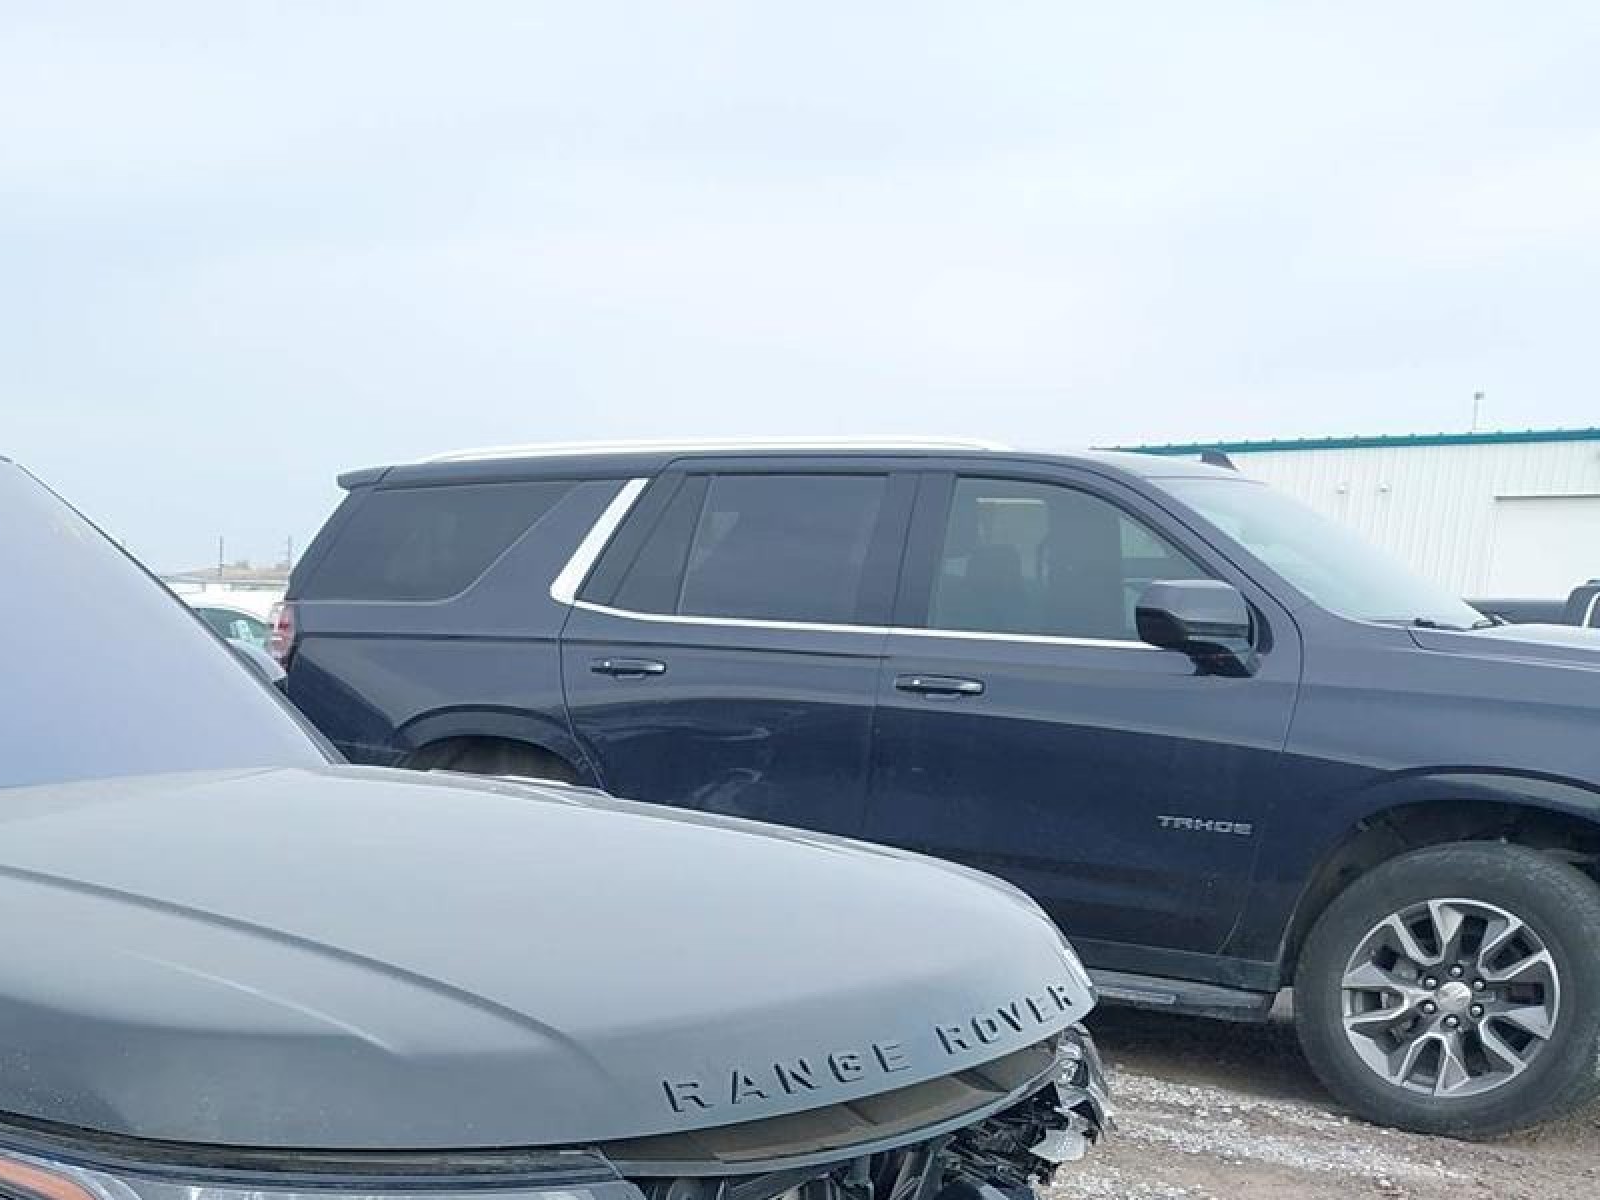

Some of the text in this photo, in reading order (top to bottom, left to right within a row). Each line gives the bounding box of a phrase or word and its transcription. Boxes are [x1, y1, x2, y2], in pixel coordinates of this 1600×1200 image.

[1156, 815, 1252, 835] TAHOE
[661, 984, 1074, 1113] RANGE ROVER
